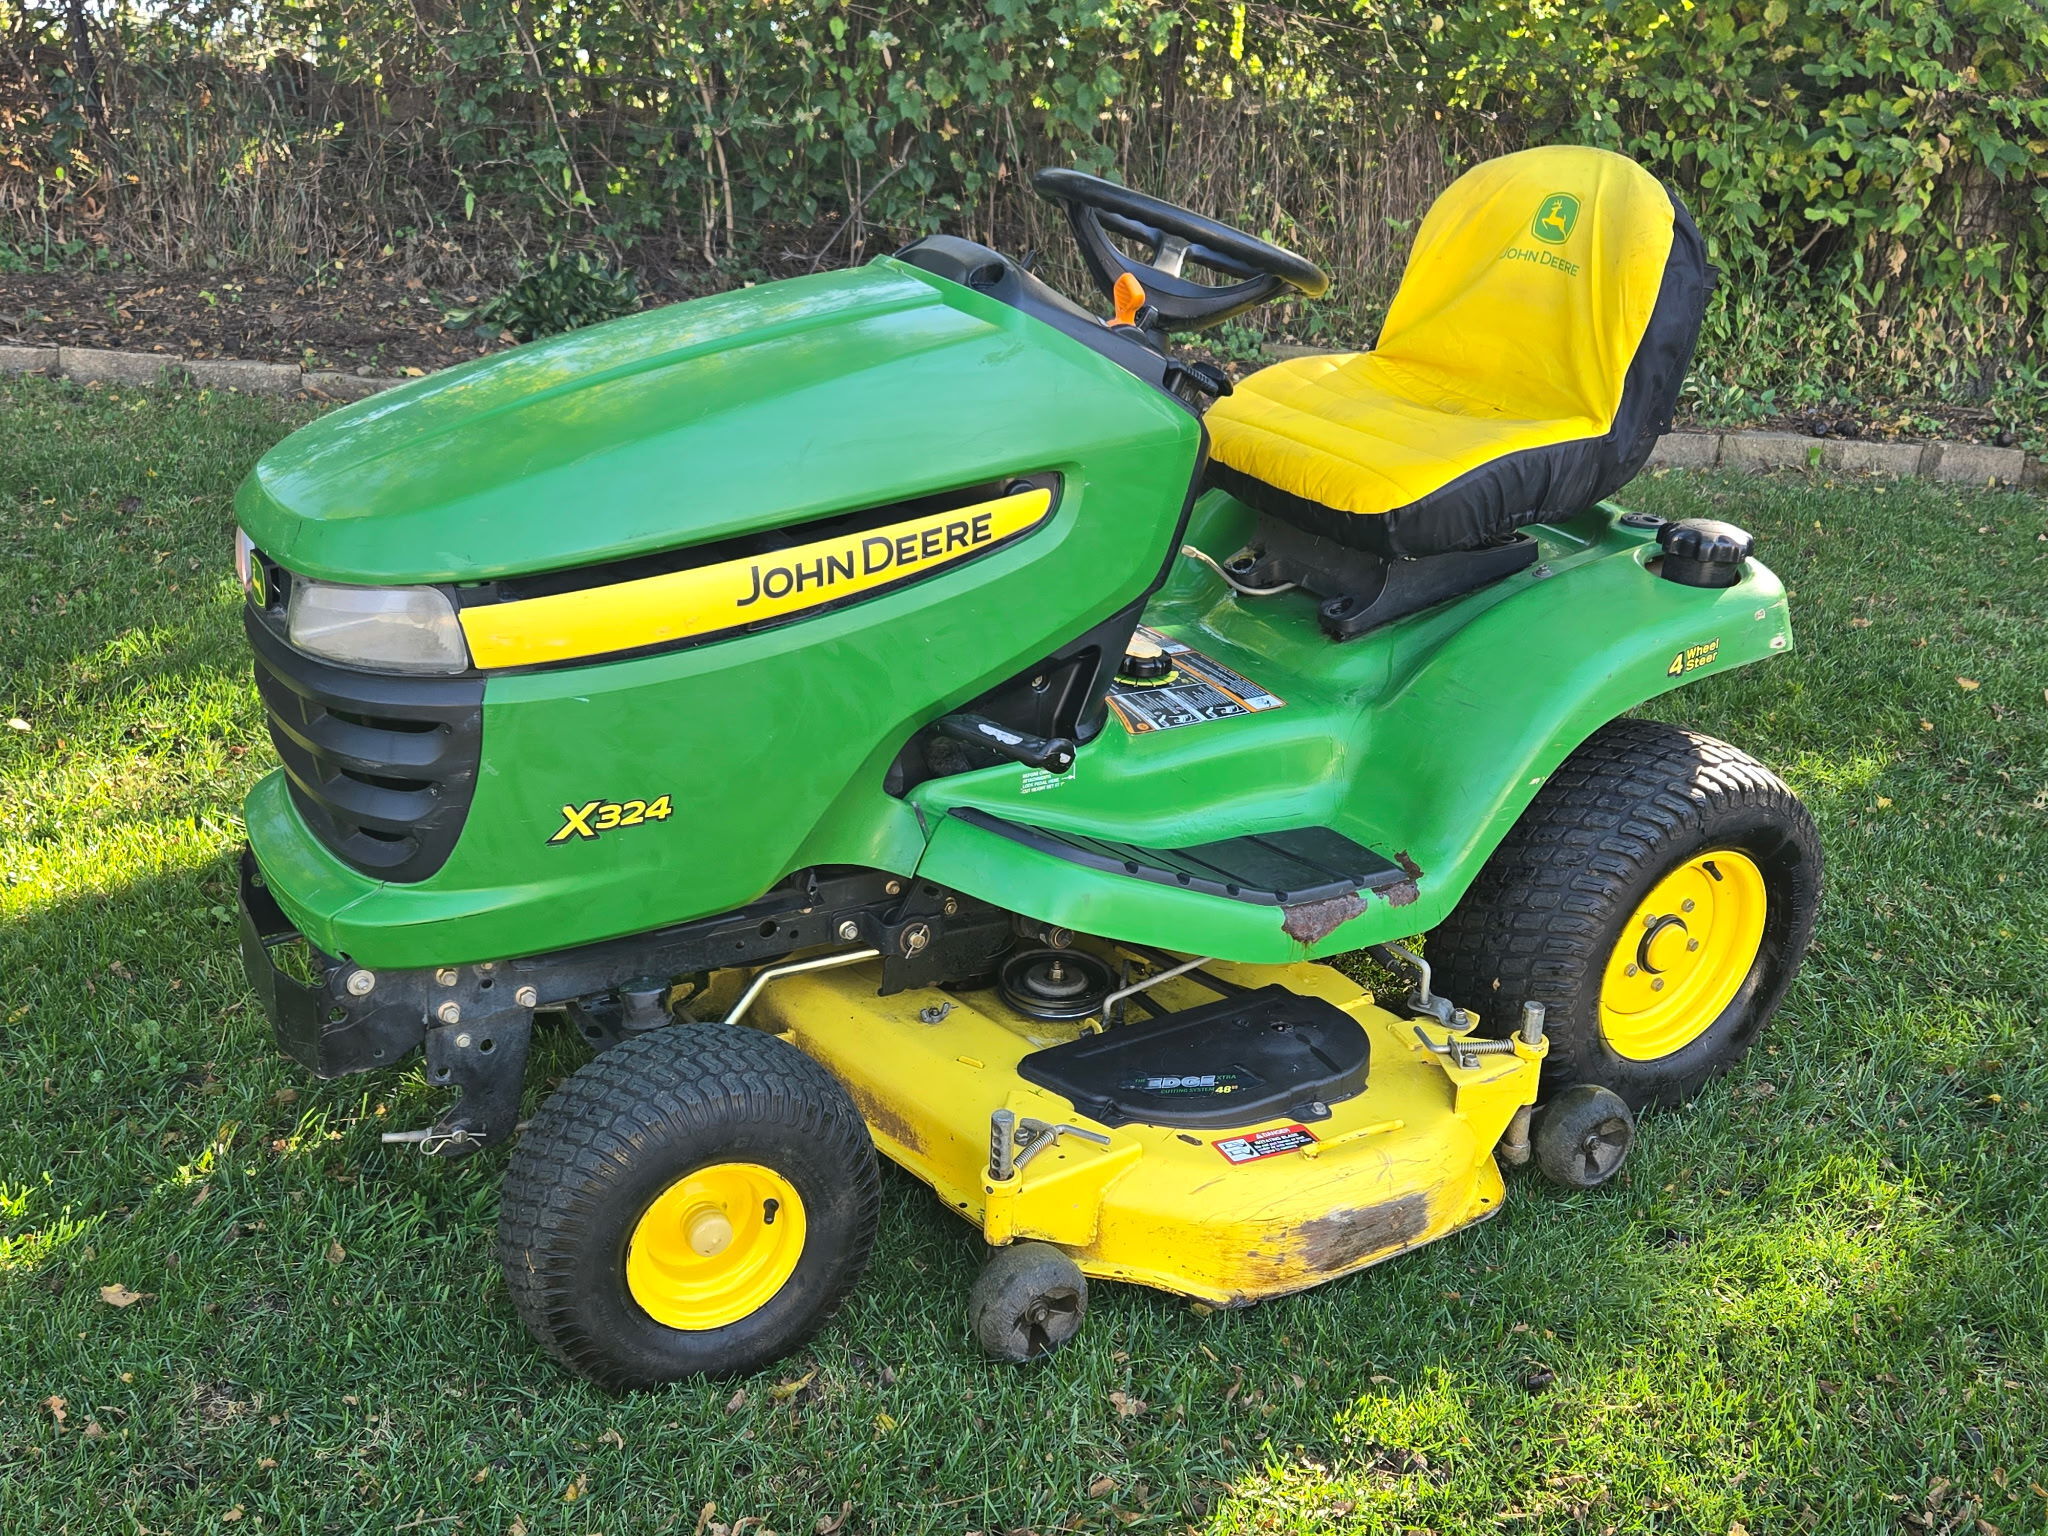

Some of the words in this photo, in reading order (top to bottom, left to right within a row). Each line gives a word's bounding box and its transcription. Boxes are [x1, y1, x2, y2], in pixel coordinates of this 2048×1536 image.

[1499, 247, 1539, 263] JOHN
[1540, 250, 1580, 277] DEERE
[736, 550, 855, 607] JOHN
[862, 512, 993, 576] DEERE
[1667, 651, 1685, 678] 4
[1686, 637, 1720, 660] Wheel
[1685, 651, 1718, 672] Steer
[545, 794, 673, 847] X324
[1144, 1075, 1216, 1090] EDGE
